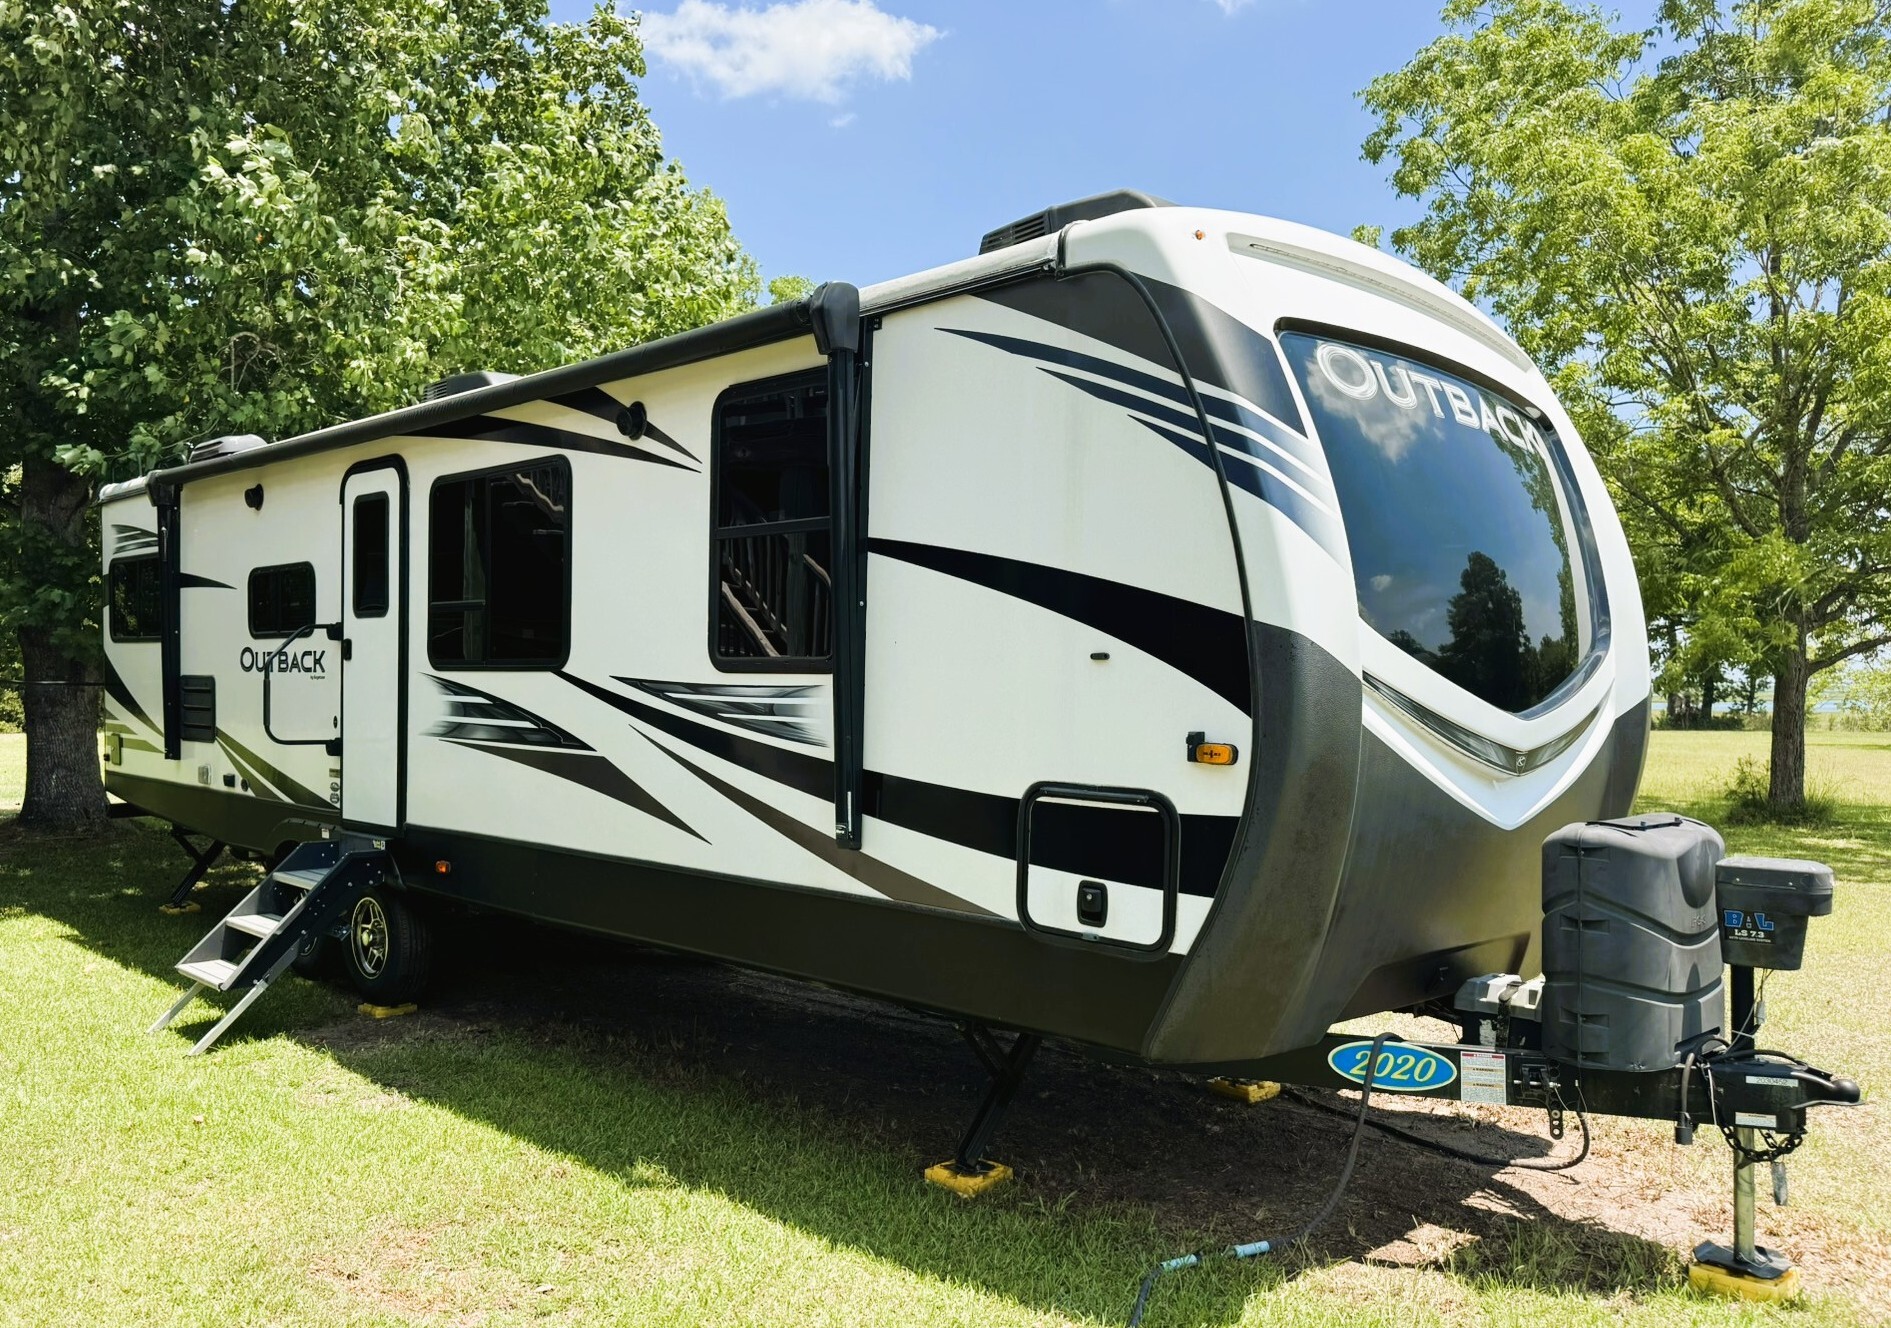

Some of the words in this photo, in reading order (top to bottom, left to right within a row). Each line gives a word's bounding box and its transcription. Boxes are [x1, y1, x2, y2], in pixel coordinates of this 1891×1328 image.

[1316, 341, 1546, 460] OUTBACK
[240, 646, 326, 673] OUTBACK
[1734, 929, 1748, 937] LS
[1750, 930, 1765, 938] 7.3
[1349, 1050, 1437, 1082] 2020
